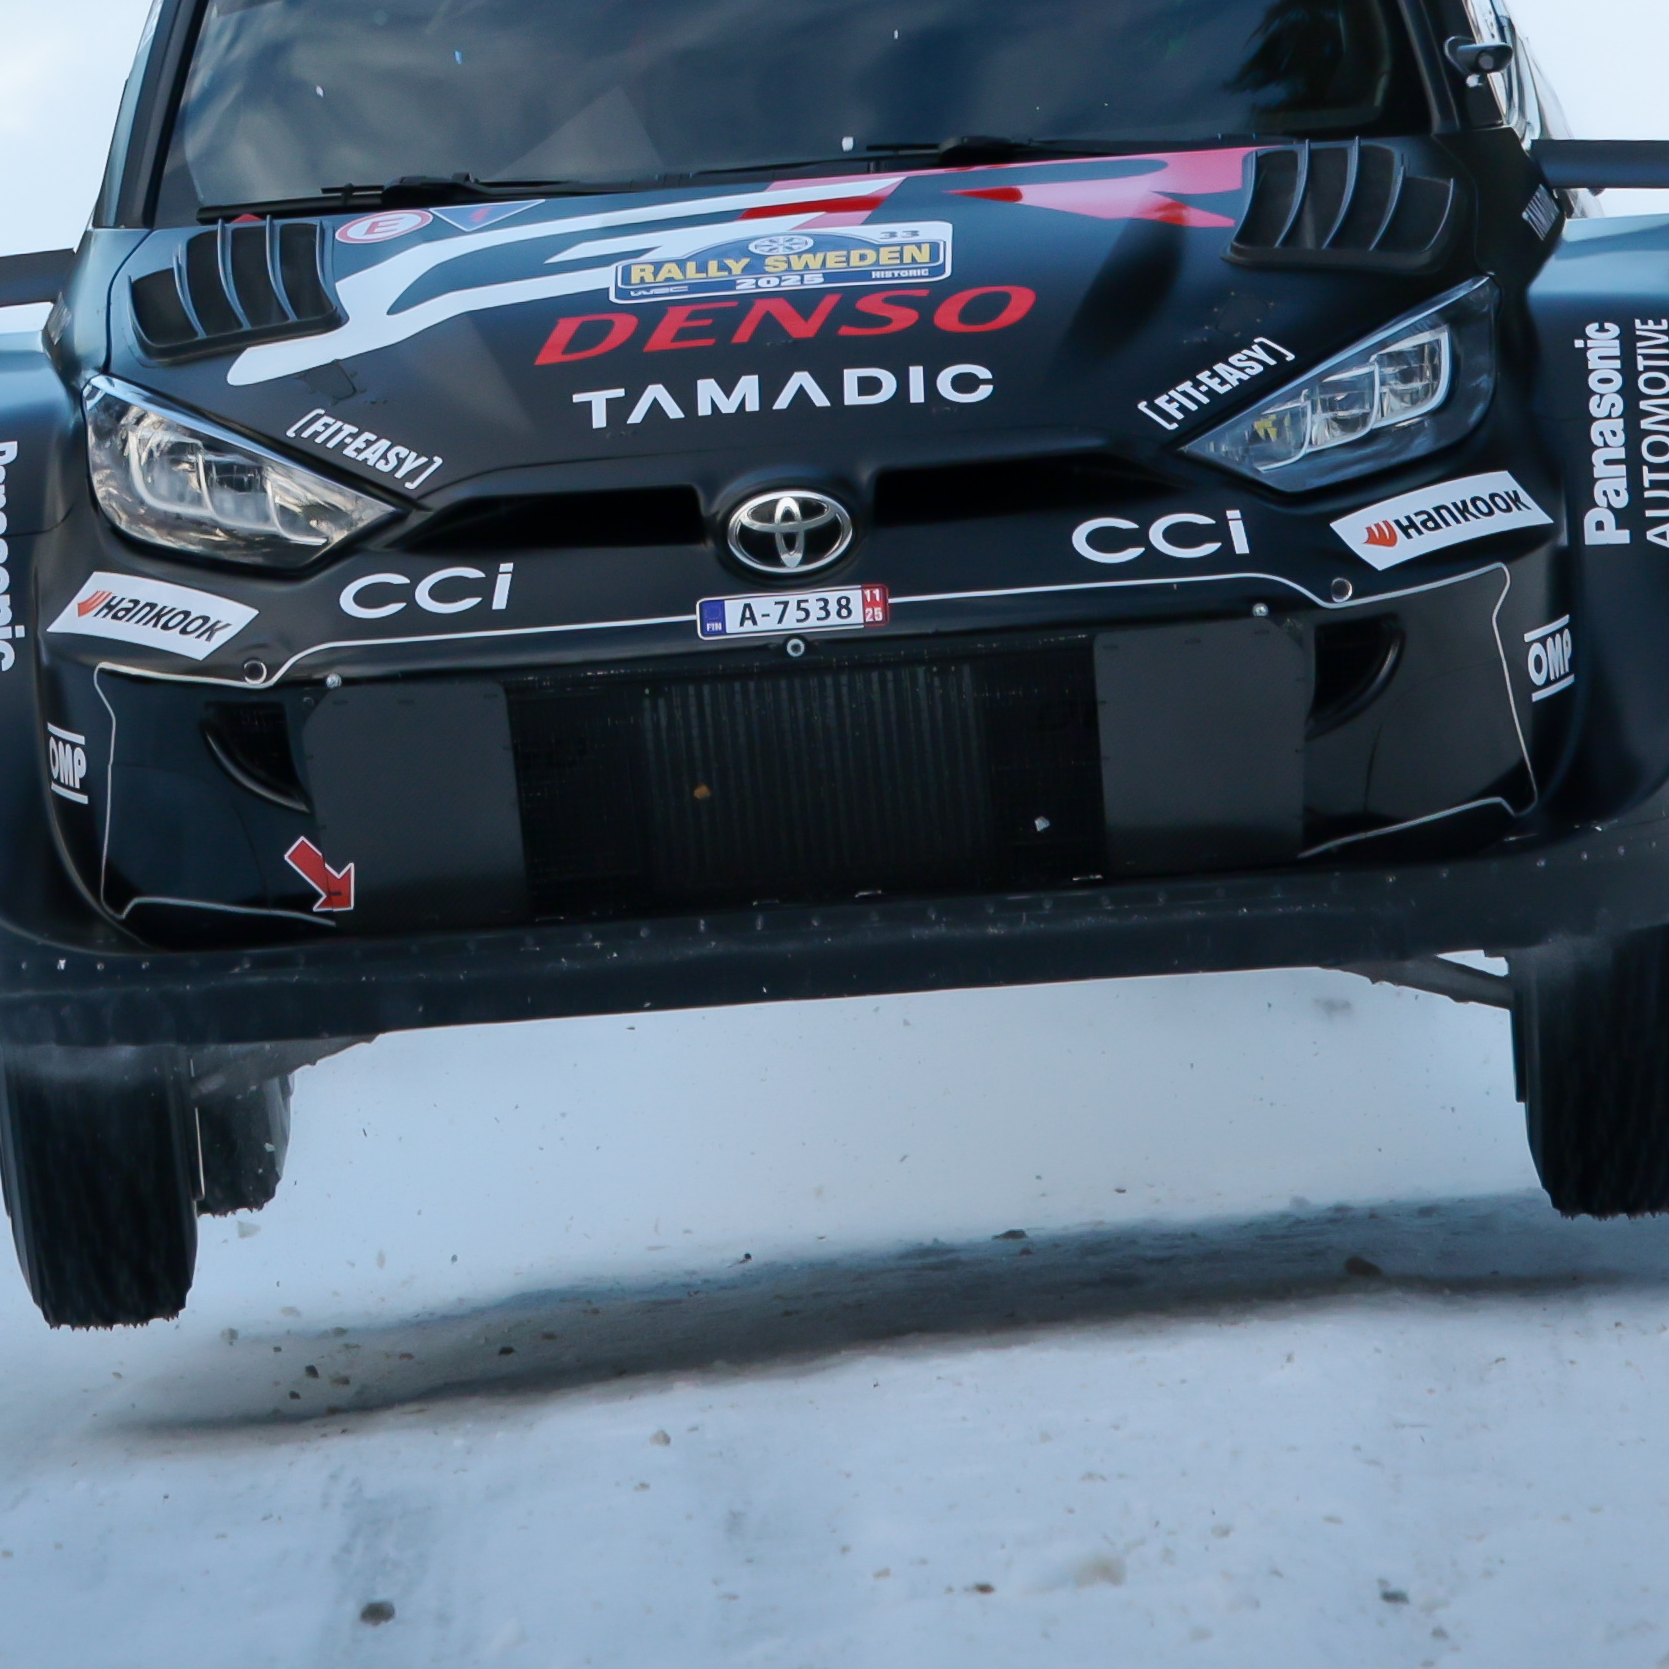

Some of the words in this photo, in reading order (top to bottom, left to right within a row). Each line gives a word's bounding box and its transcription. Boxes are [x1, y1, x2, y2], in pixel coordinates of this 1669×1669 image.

[630, 257, 752, 285] RALLY
[763, 242, 931, 274] SWEDEN
[734, 272, 825, 291] 2025
[533, 284, 1037, 366] DENSO
[572, 363, 995, 430] TAMADIC
[1573, 321, 1631, 546] Panasonic
[738, 595, 854, 628] A-7538
[863, 588, 881, 602] 11
[865, 607, 884, 623] 25
[1527, 627, 1572, 686] OMP
[48, 735, 87, 789] OMP
